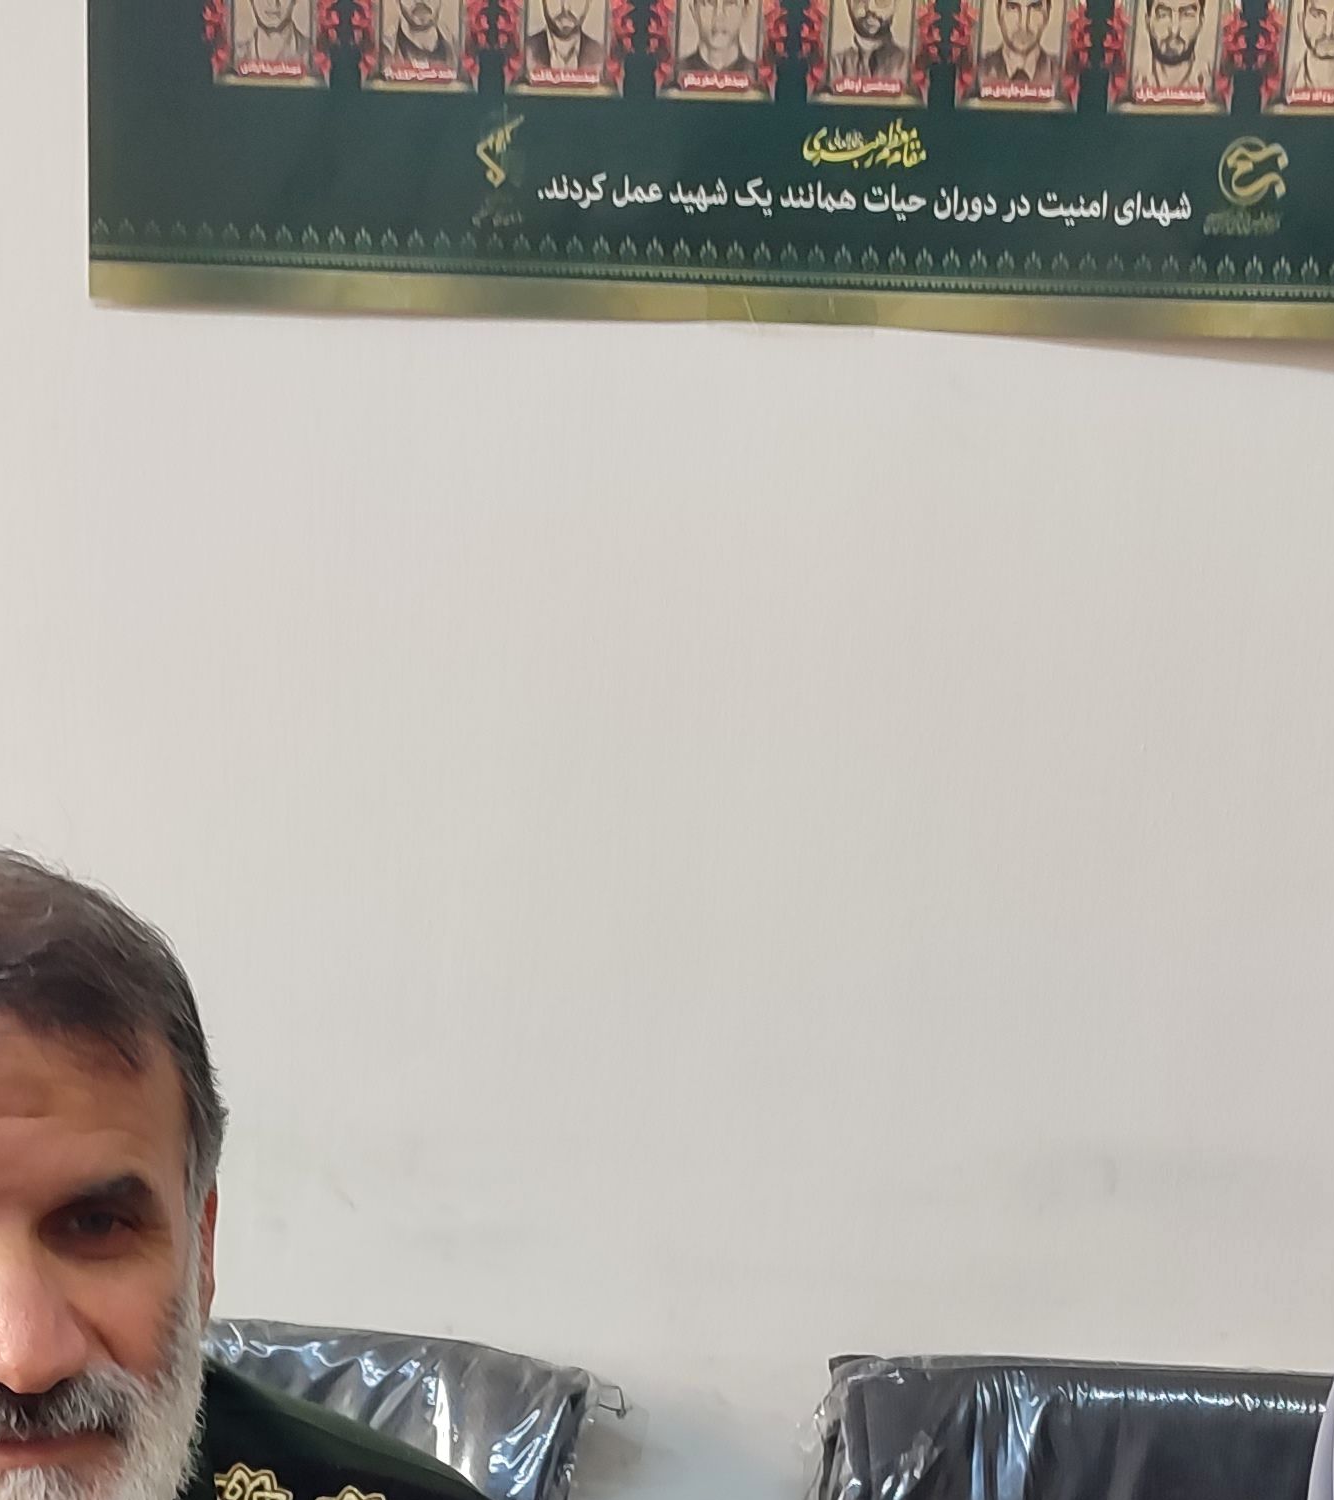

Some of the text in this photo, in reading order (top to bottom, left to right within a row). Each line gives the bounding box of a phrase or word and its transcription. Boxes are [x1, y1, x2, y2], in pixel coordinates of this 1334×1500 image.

[537, 172, 607, 209] کردند.
[612, 174, 664, 208] عمل
[669, 177, 728, 214] شهید
[734, 176, 773, 218] یک
[780, 180, 857, 213] همانند
[864, 183, 927, 221] حیات
[933, 186, 997, 222] دوران
[1002, 193, 1031, 223] در
[1037, 189, 1108, 227] امنیت
[1113, 189, 1192, 227] شهدای
